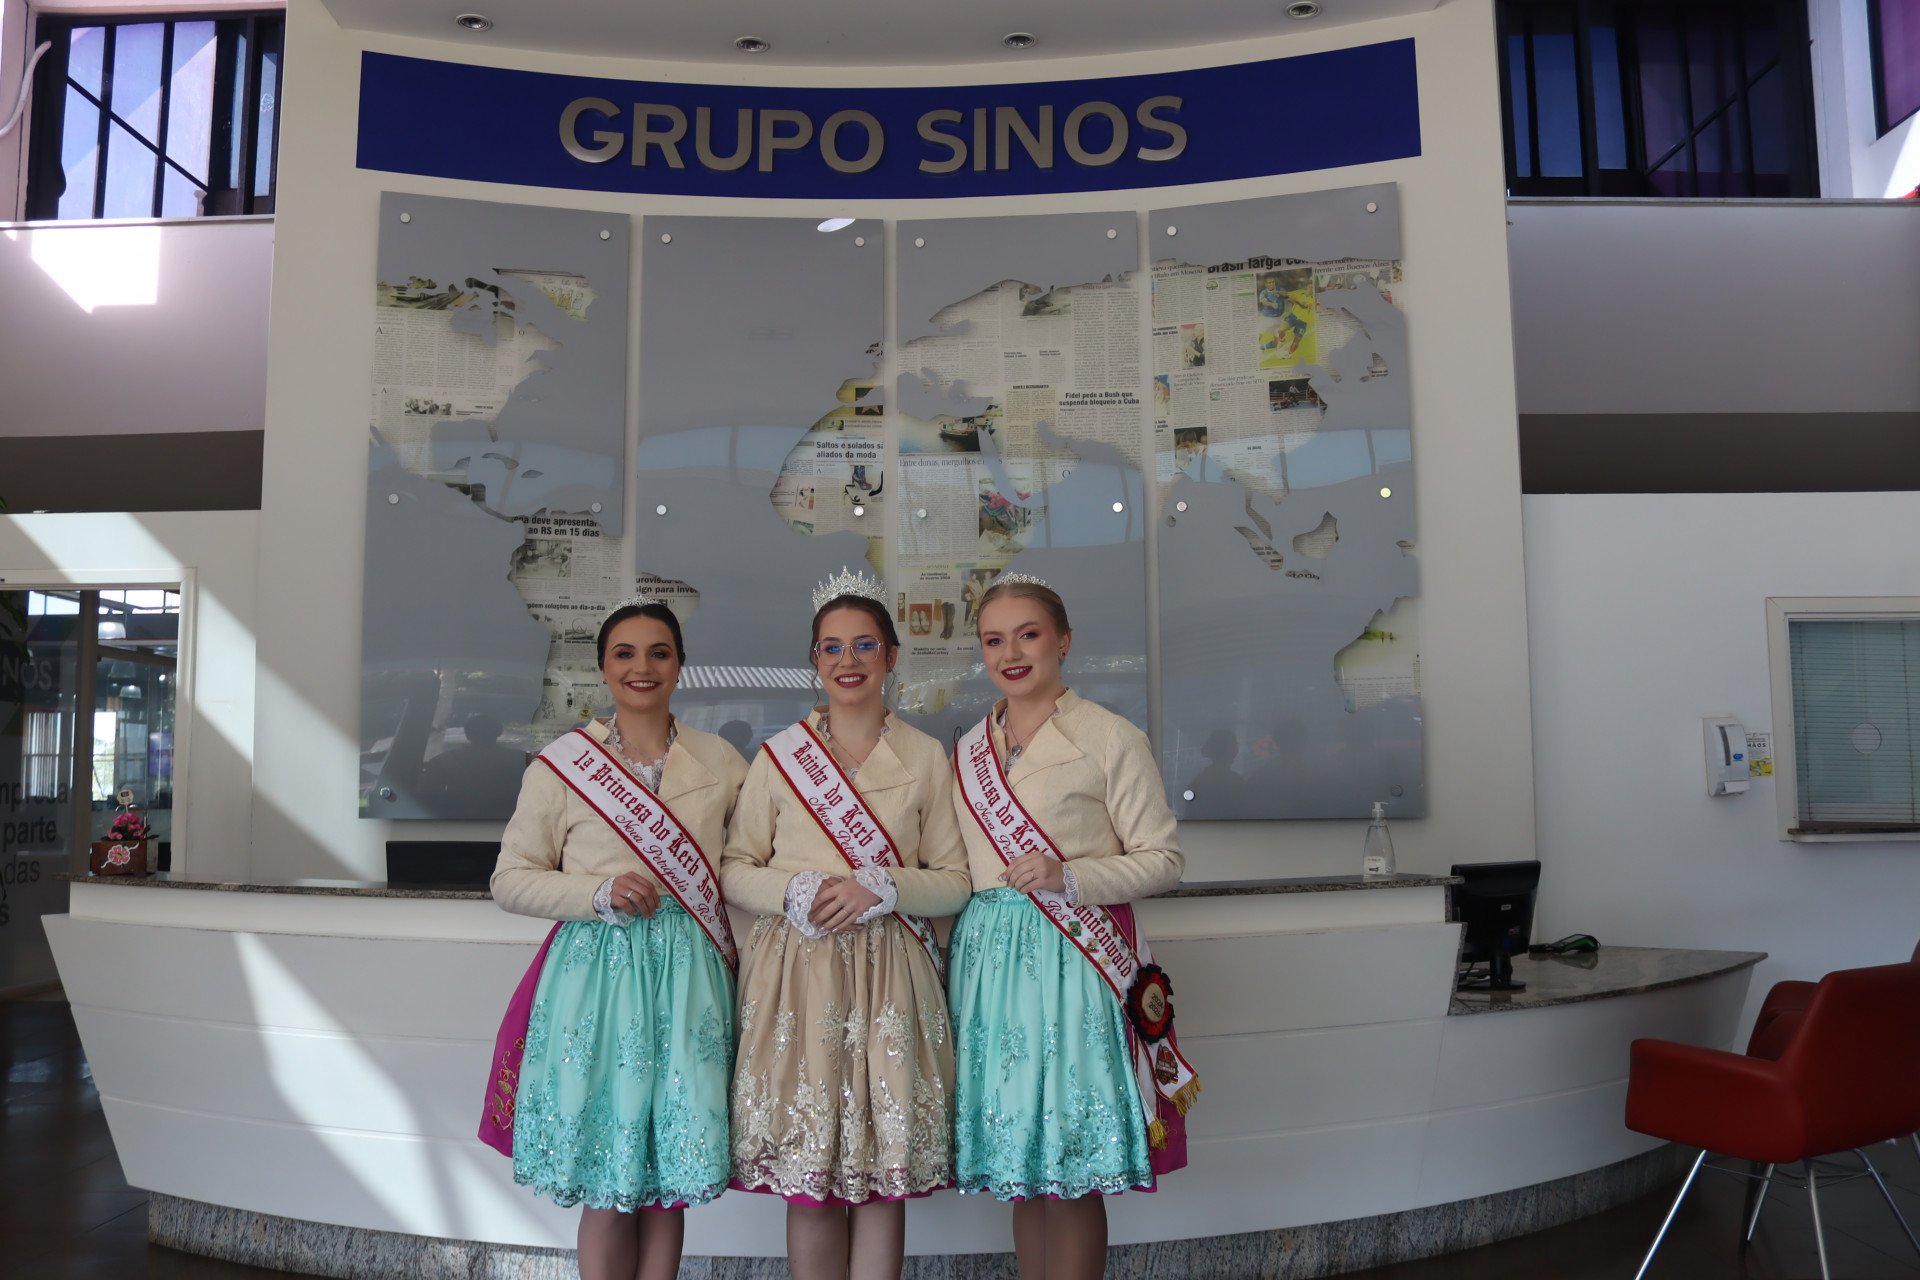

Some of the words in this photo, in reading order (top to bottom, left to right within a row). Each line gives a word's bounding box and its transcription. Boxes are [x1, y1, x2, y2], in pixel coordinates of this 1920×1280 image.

[558, 96, 885, 174] GRUPO
[917, 95, 1188, 174] SINOS
[1082, 392, 1098, 400] pede
[1090, 398, 1117, 406] bloqueio
[816, 441, 839, 449] Saltos
[847, 442, 875, 450] solados
[816, 451, 843, 459] aliados
[845, 451, 854, 459] da
[856, 451, 877, 459] moda
[899, 459, 917, 467] Entre
[941, 457, 976, 467] mergulhos
[531, 516, 551, 525] deve
[528, 527, 538, 535] ao
[541, 526, 552, 535] RS
[569, 528, 580, 536] 15
[582, 528, 600, 538] dias
[655, 586, 675, 594] para
[544, 602, 570, 611] soluções
[791, 740, 829, 787] Rainha
[823, 782, 844, 807] do
[839, 803, 878, 848] Kerb
[969, 745, 1001, 807] Princesa
[996, 801, 1015, 827] do
[1009, 819, 1050, 854] Ker
[808, 796, 833, 828] Nova
[975, 801, 996, 832] Nova
[3, 820, 58, 852] parte
[588, 763, 653, 824] Princesa
[648, 814, 671, 842] do
[666, 832, 700, 877] Kerb
[696, 873, 714, 904] Im
[614, 814, 644, 844] Nova
[642, 844, 688, 894] Petrópolis
[692, 903, 716, 924] RS
[1041, 899, 1071, 922] RS
